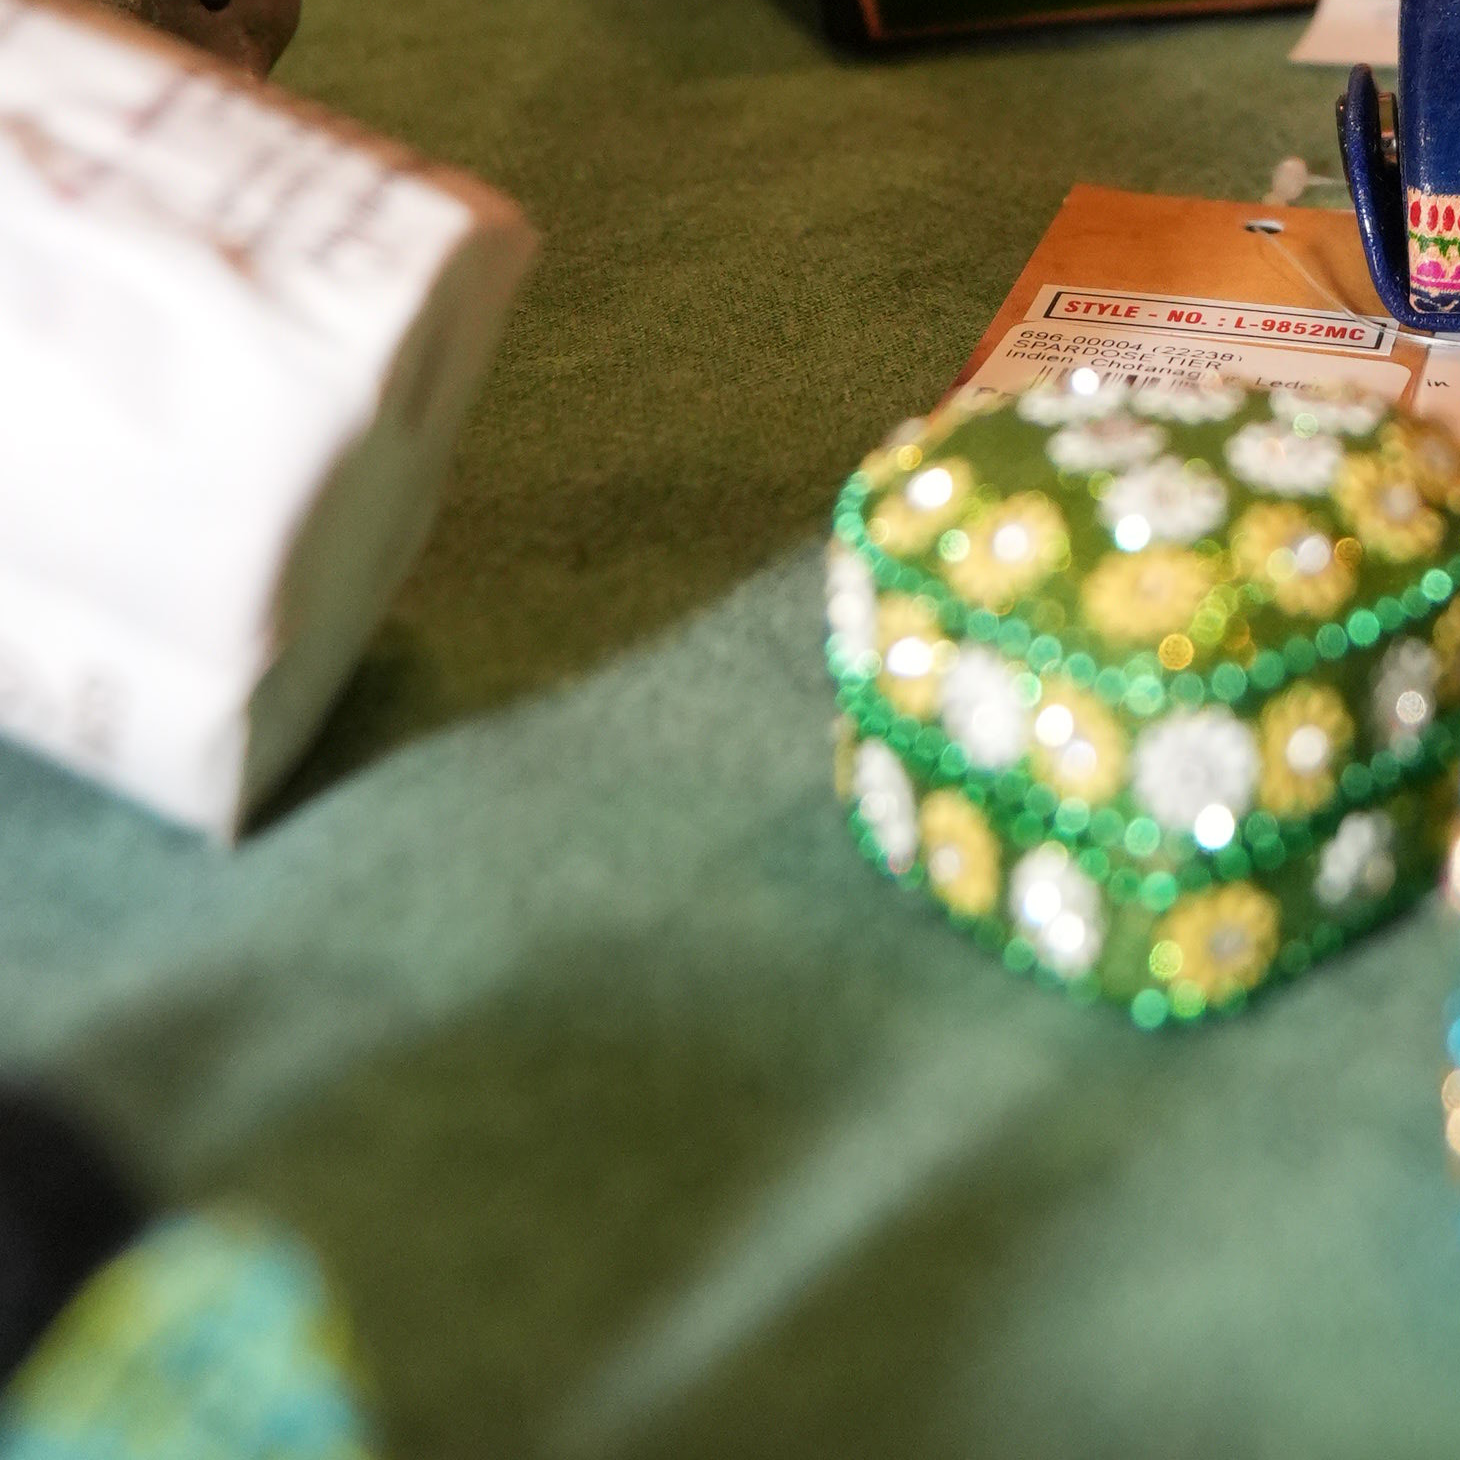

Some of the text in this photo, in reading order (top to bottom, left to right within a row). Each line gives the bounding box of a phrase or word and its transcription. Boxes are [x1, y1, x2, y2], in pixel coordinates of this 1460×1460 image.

[1063, 299, 1141, 319] STYLE
[1166, 309, 1207, 326] NO.
[1233, 316, 1367, 341] L-9852MC
[1013, 339, 1223, 372] SPARDOSE TIER
[1019, 329, 1244, 363] 696-00004 (22238)
